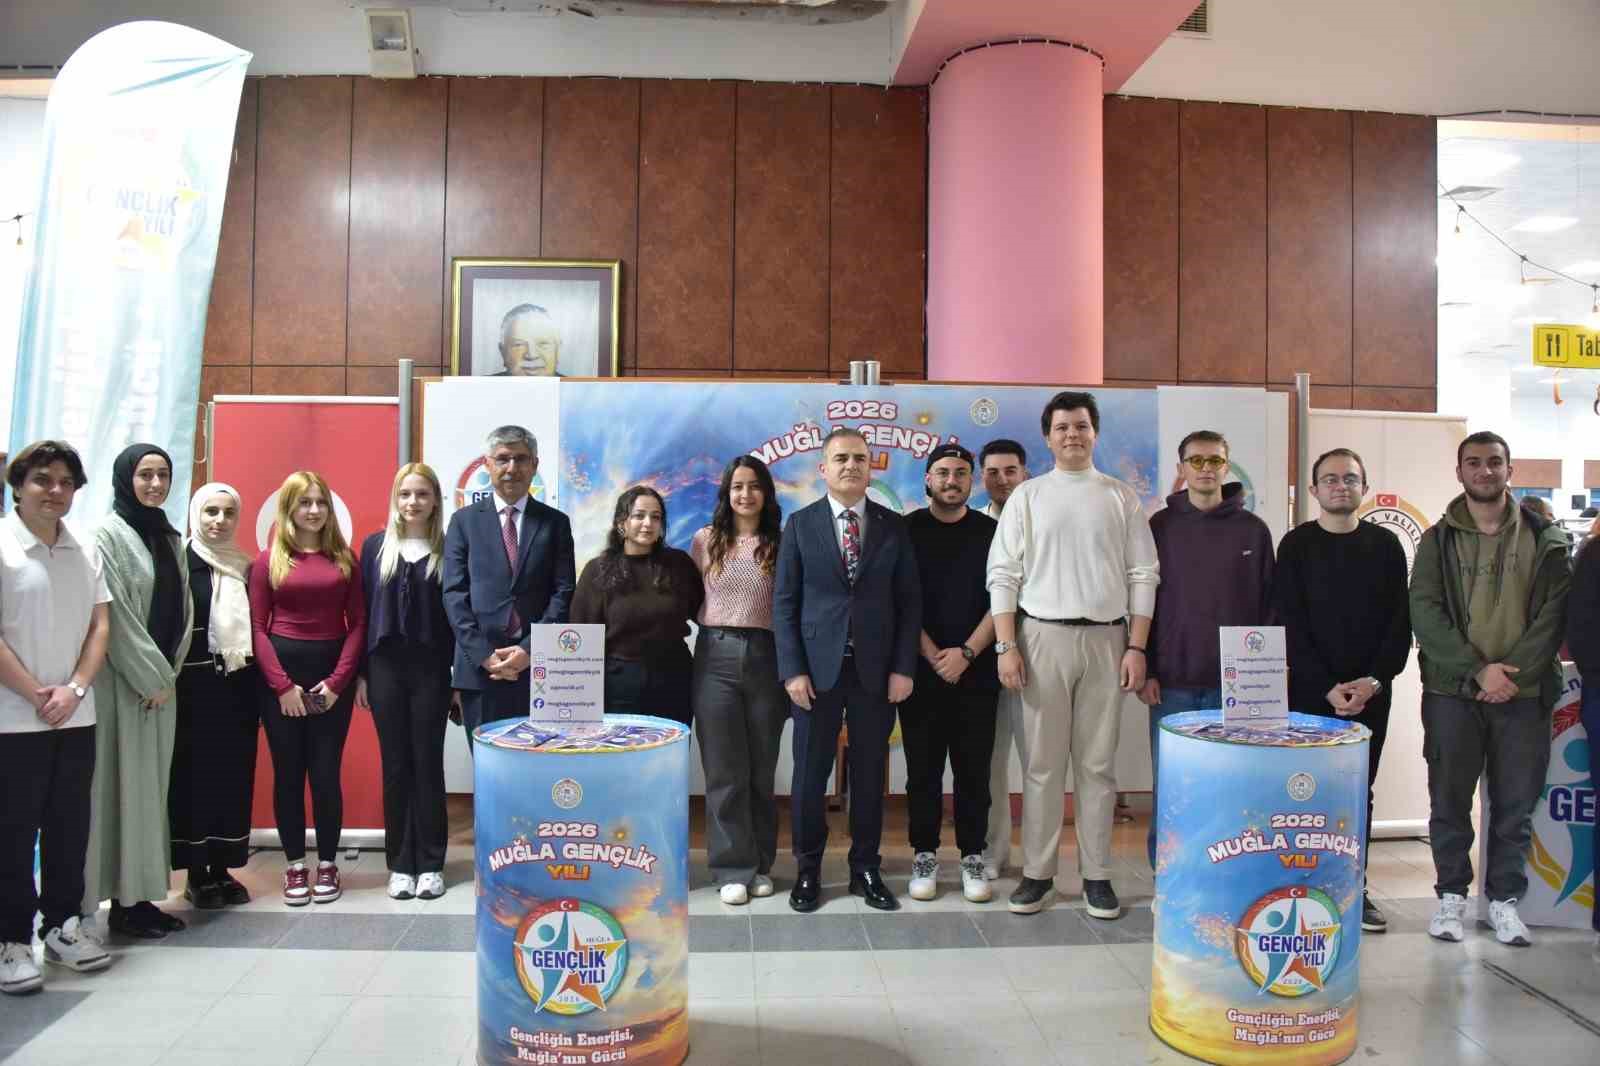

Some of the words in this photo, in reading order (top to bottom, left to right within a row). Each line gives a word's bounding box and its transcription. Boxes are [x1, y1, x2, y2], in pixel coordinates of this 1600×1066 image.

[828, 400, 898, 420] 2026
[750, 422, 845, 466] MUĞL
[537, 822, 599, 839] 2026
[1270, 813, 1328, 829] 2026
[488, 839, 557, 872] MUĞLA
[562, 842, 658, 874] GENÇLİK
[1208, 831, 1289, 863] MUĞLA
[1295, 832, 1361, 860] GENÇLİK
[1279, 854, 1319, 869] YILI
[546, 864, 591, 880] YILI
[1259, 931, 1326, 956] GENÇLİK
[532, 948, 606, 973] GENÇLİK
[1303, 952, 1325, 967] YILI
[578, 969, 605, 984] YILI
[1227, 1008, 1293, 1028] Gençliğin
[510, 1026, 573, 1047] Gençliğin
[577, 1028, 634, 1046] Enerjisi,
[591, 1047, 626, 1064] Gücü
